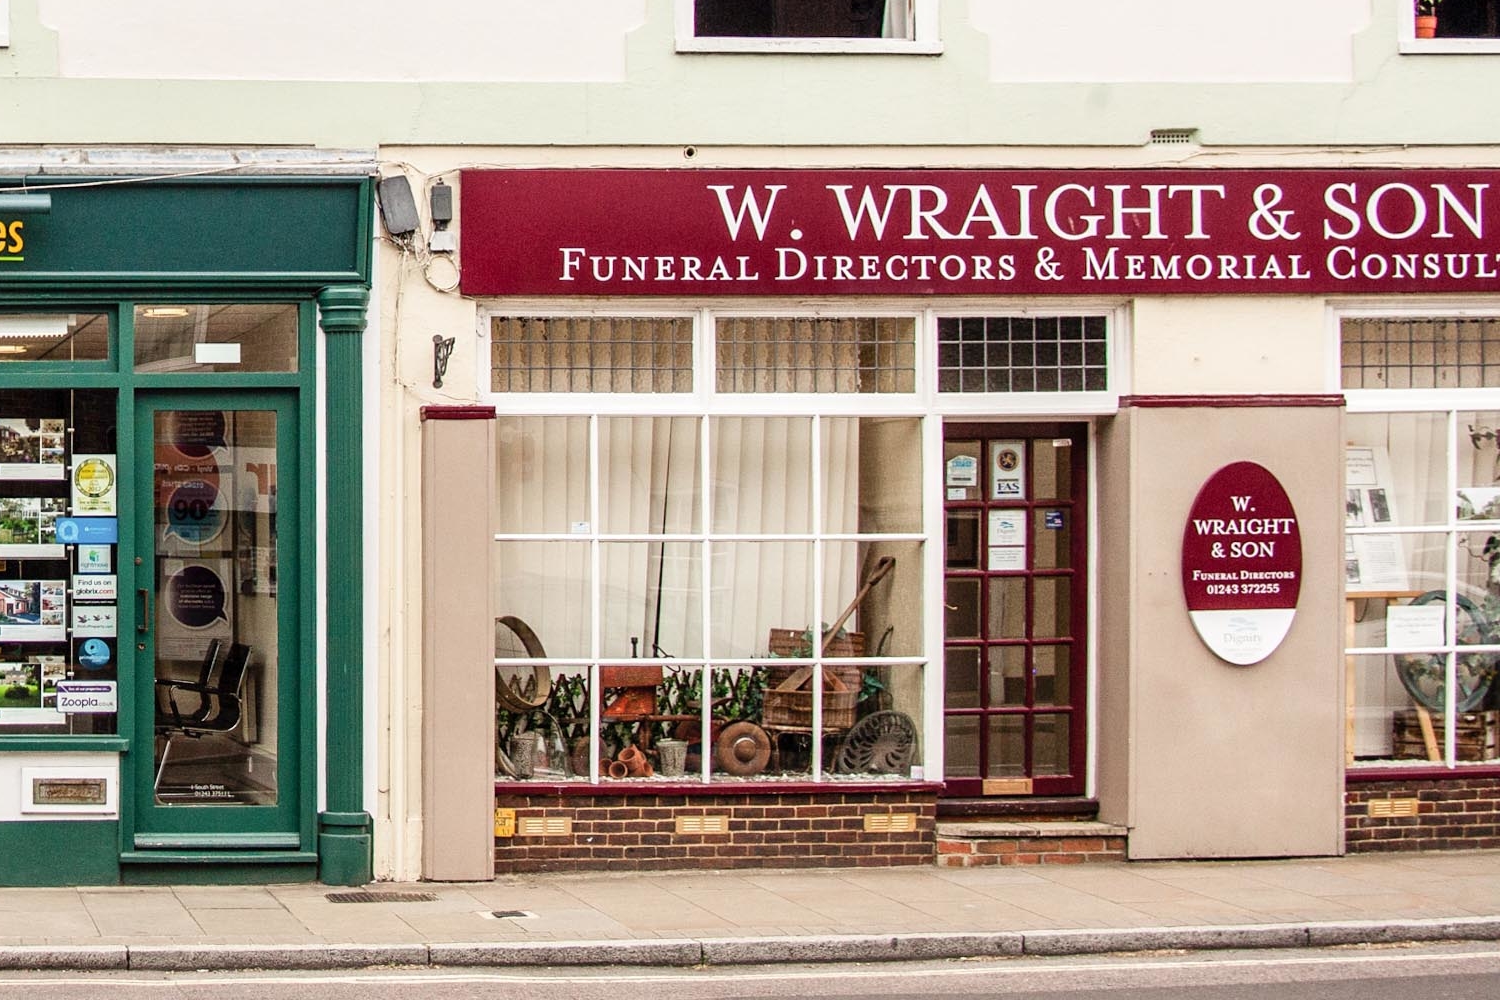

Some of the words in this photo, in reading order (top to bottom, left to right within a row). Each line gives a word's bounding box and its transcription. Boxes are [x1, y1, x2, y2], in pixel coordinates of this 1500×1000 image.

[707, 184, 804, 241] W.
[826, 183, 1225, 241] WRAIGHT
[1248, 182, 1301, 241] &
[1323, 182, 1490, 240] SON
[559, 247, 759, 281] FUNERAL
[775, 246, 1016, 281] DIRECTORS
[1034, 246, 1065, 280] &
[1082, 246, 1311, 280] MEMORIAL
[1326, 244, 1500, 280] CONSUL
[1231, 496, 1256, 512] W.
[1193, 518, 1294, 535] WRAIGHT
[1211, 542, 1226, 558] &
[1230, 542, 1275, 558] SON
[1192, 570, 1238, 580] FUNERAL
[1240, 570, 1295, 580] DIRECTORS
[1206, 584, 1239, 595] 01243
[1241, 583, 1280, 594] 372255
